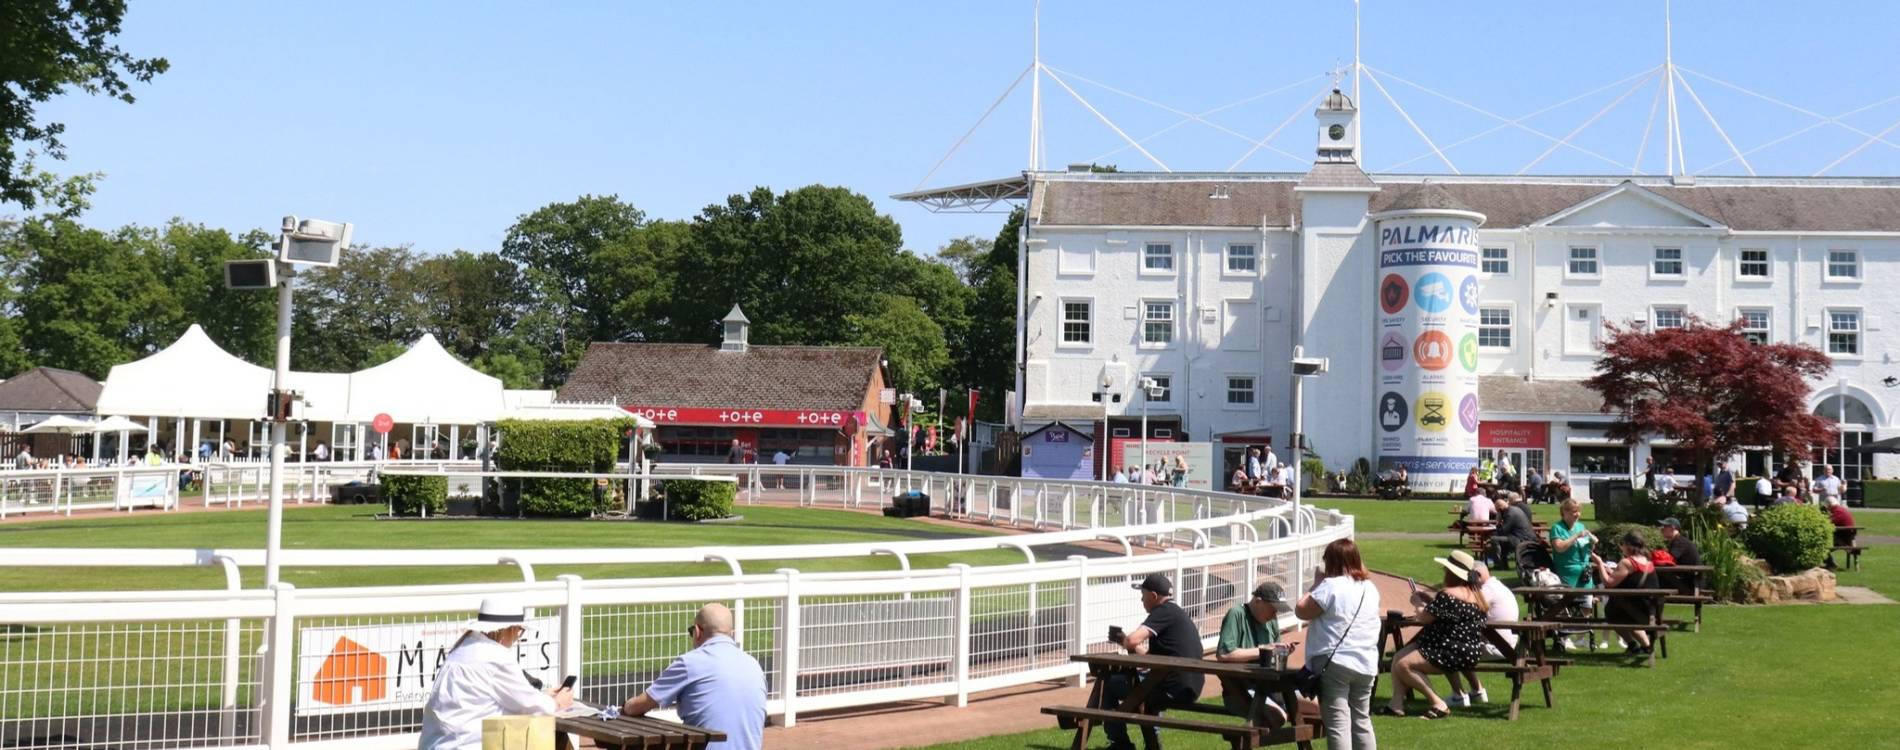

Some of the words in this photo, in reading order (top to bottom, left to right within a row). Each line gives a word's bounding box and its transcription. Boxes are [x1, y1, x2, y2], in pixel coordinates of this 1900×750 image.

[1381, 225, 1478, 246] PALMARIS
[1383, 251, 1403, 264] PICK
[1405, 250, 1426, 262] THE
[1428, 250, 1477, 265] FAVOURITE
[719, 409, 763, 423] tote
[797, 411, 843, 424] tote
[396, 630, 552, 688] MAE'S
